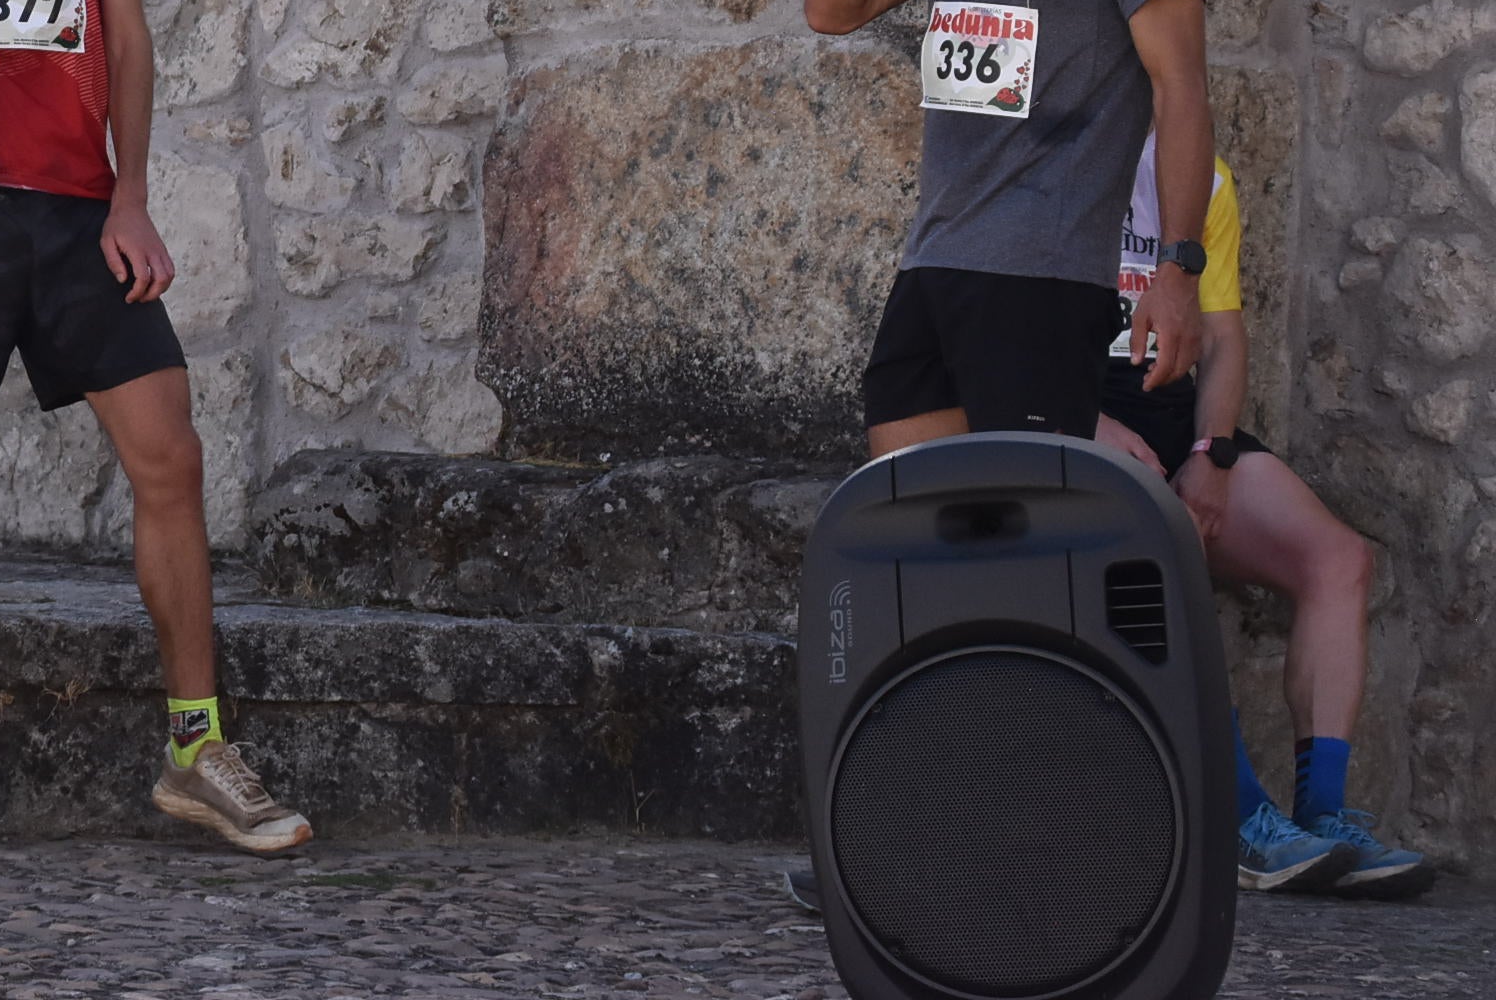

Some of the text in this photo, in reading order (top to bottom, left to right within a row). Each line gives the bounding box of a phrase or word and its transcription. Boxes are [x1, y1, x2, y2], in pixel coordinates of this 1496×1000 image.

[929, 8, 1034, 41] bedunia
[936, 39, 1002, 84] 336
[828, 610, 846, 683] ibiza
